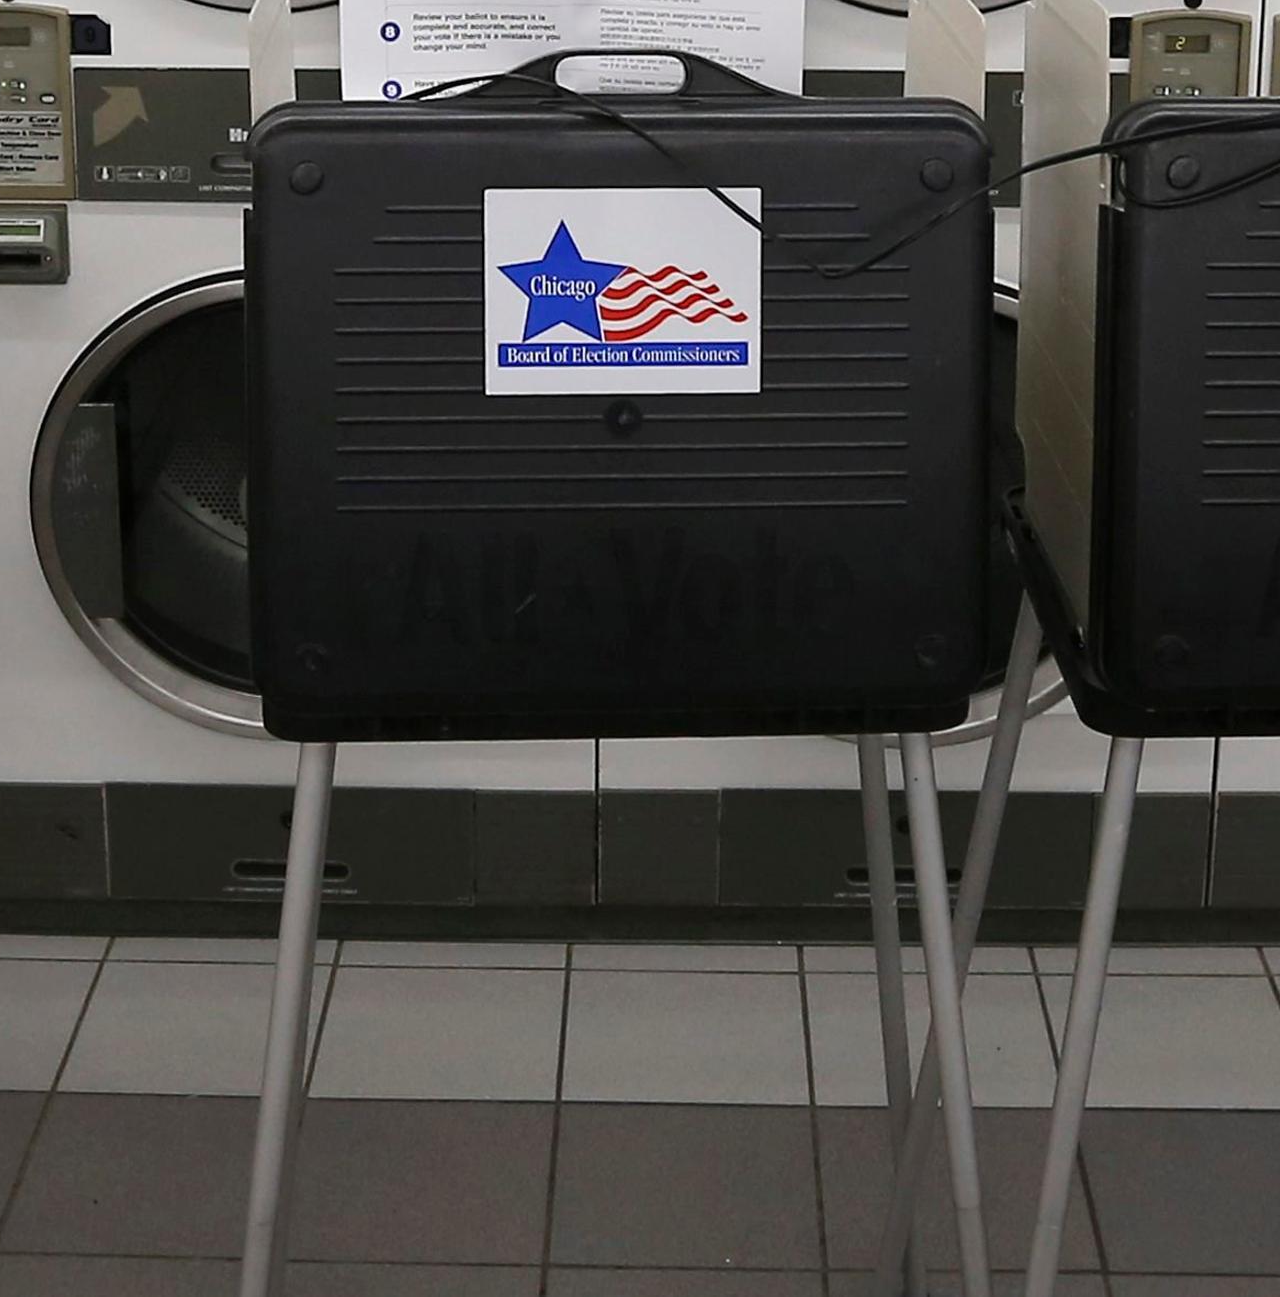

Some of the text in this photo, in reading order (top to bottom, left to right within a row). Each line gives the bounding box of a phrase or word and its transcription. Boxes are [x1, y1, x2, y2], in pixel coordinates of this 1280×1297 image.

[1176, 36, 1186, 50] 2
[530, 275, 596, 301] Chicago
[507, 346, 740, 363] Board of Election Commissioners
